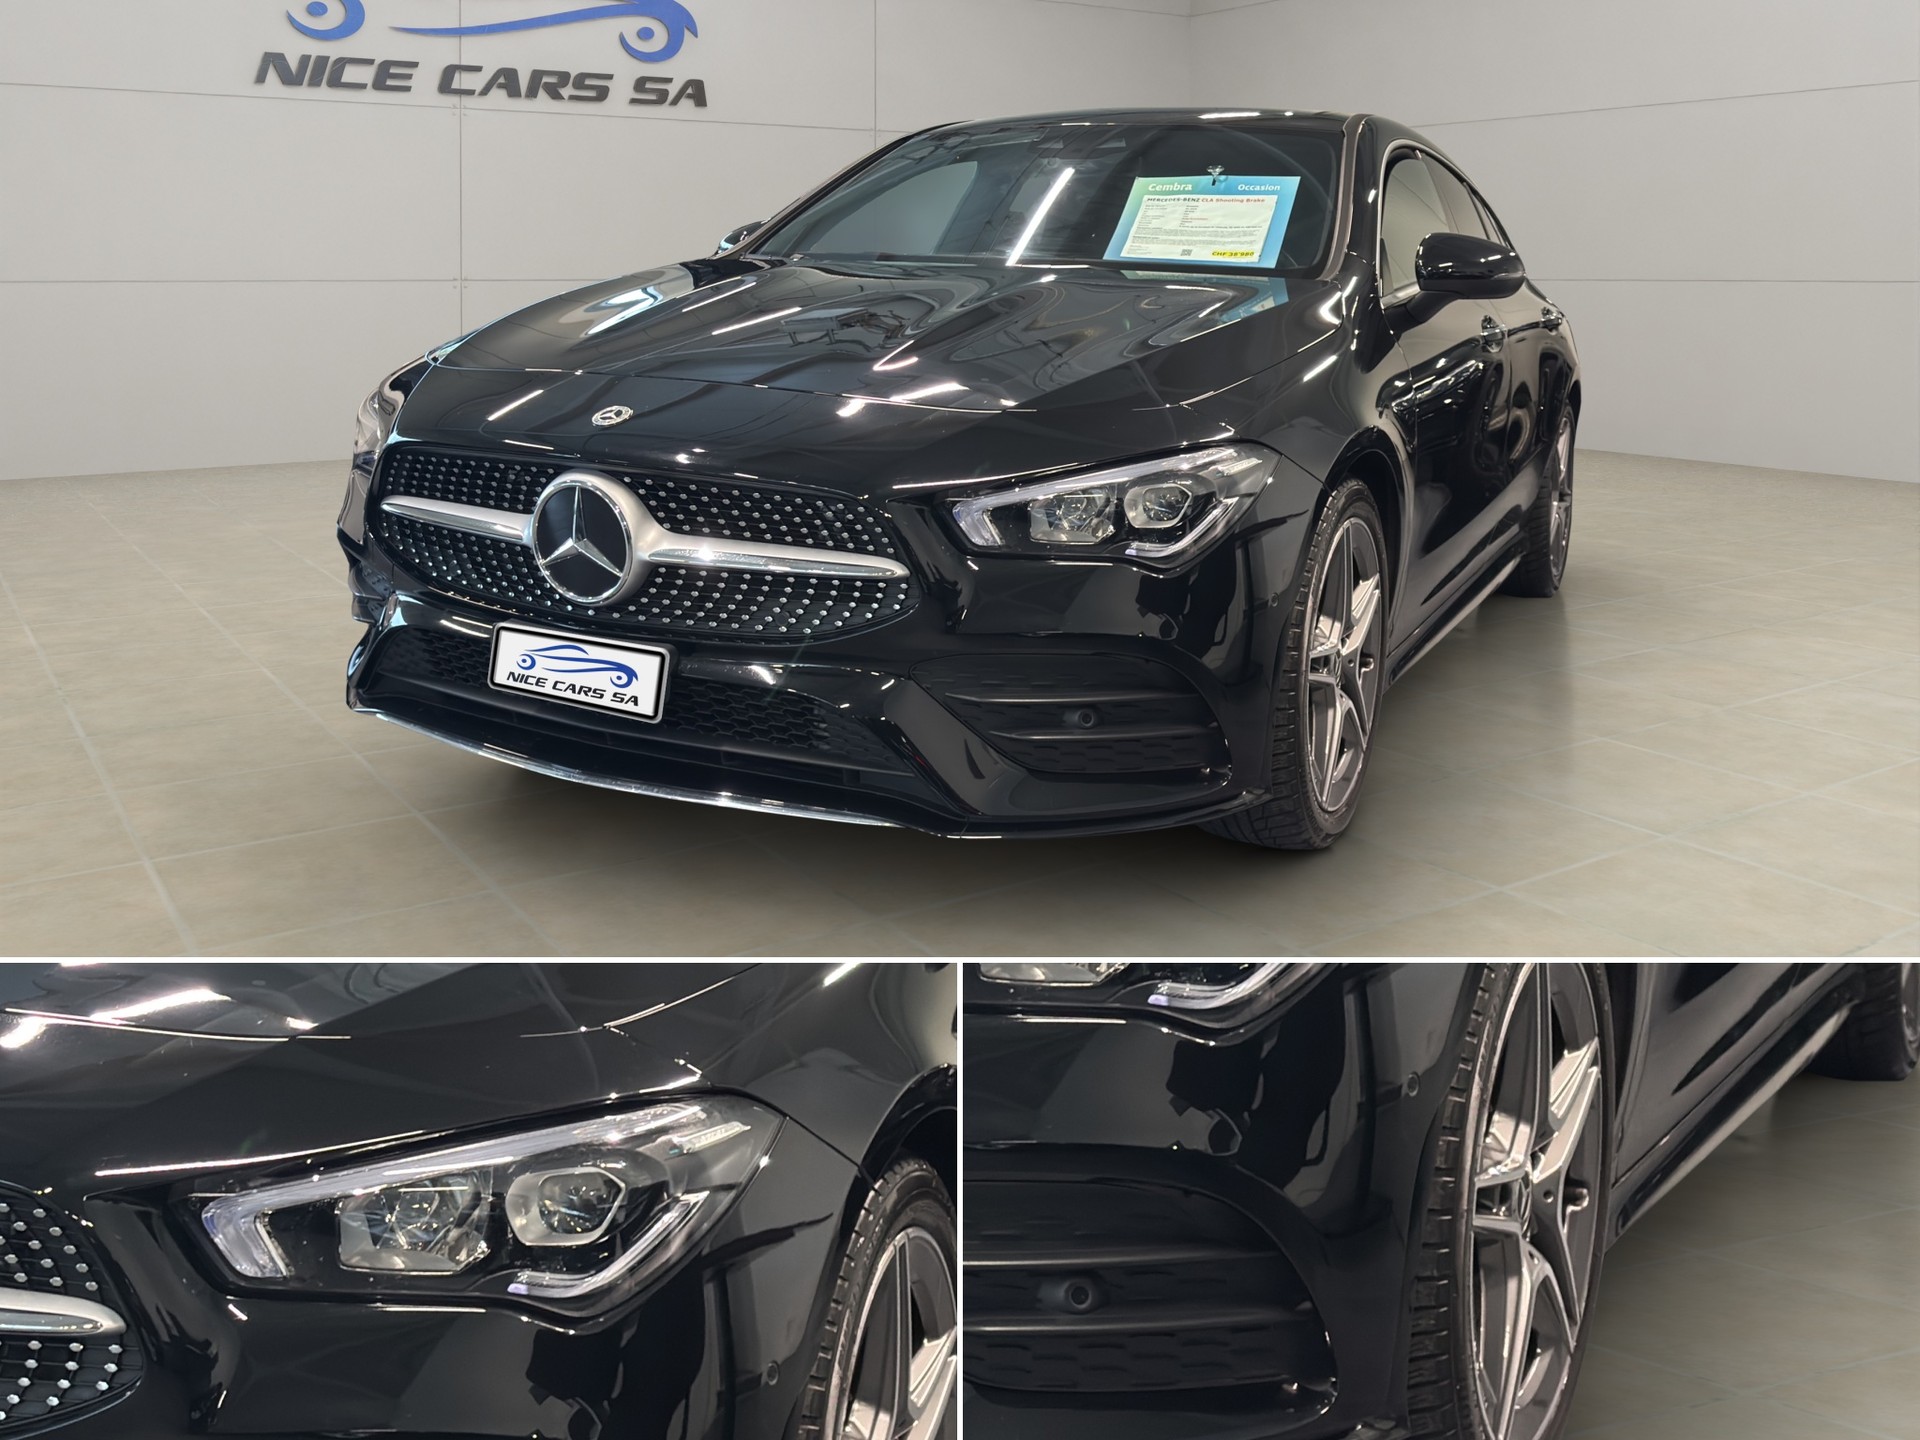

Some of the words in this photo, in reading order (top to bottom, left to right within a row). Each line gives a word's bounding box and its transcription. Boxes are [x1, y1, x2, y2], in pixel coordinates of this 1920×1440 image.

[254, 51, 418, 93] NICE
[438, 63, 614, 103] CARS
[629, 75, 708, 108] SA
[1148, 183, 1193, 192] Cembra
[1238, 183, 1281, 191] Occasion
[506, 671, 548, 688] NICE
[552, 680, 606, 699] CARS
[610, 692, 639, 706] SA
